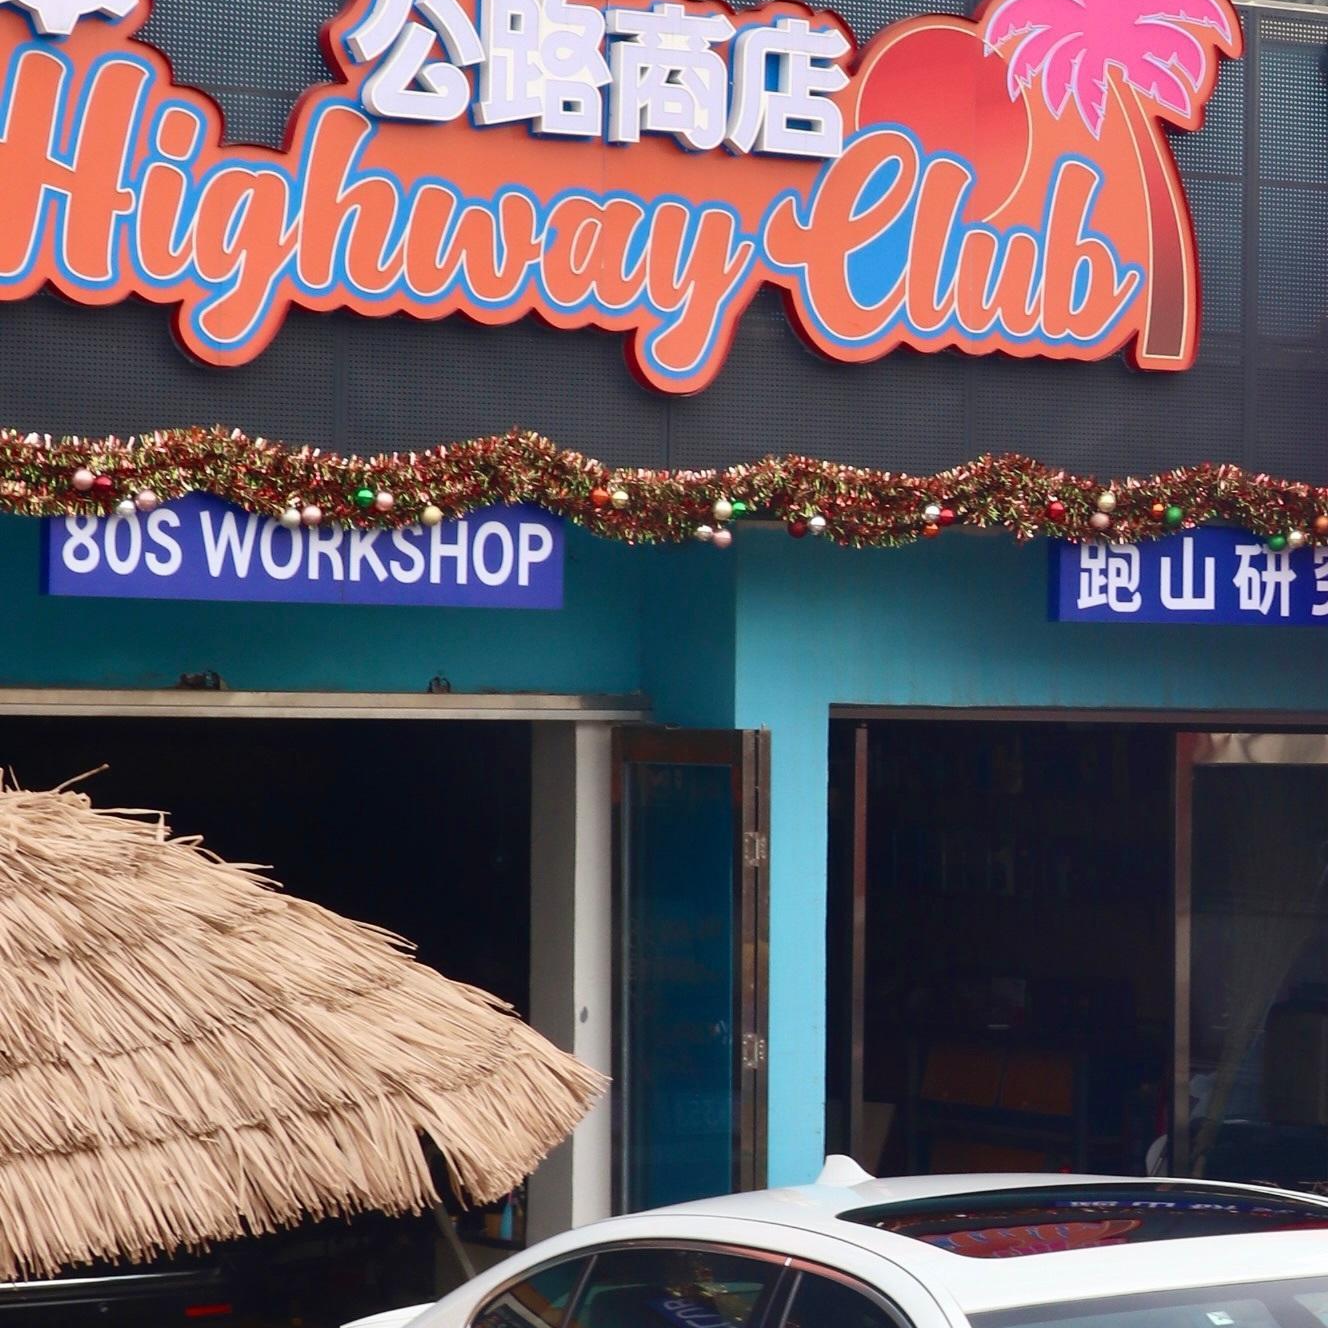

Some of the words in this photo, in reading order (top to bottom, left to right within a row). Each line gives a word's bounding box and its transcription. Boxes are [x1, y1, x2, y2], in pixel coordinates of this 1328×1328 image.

[0, 49, 755, 372] Highway
[764, 129, 1141, 341] Club
[62, 507, 182, 576] 80S
[200, 509, 554, 587] WORKSHOP
